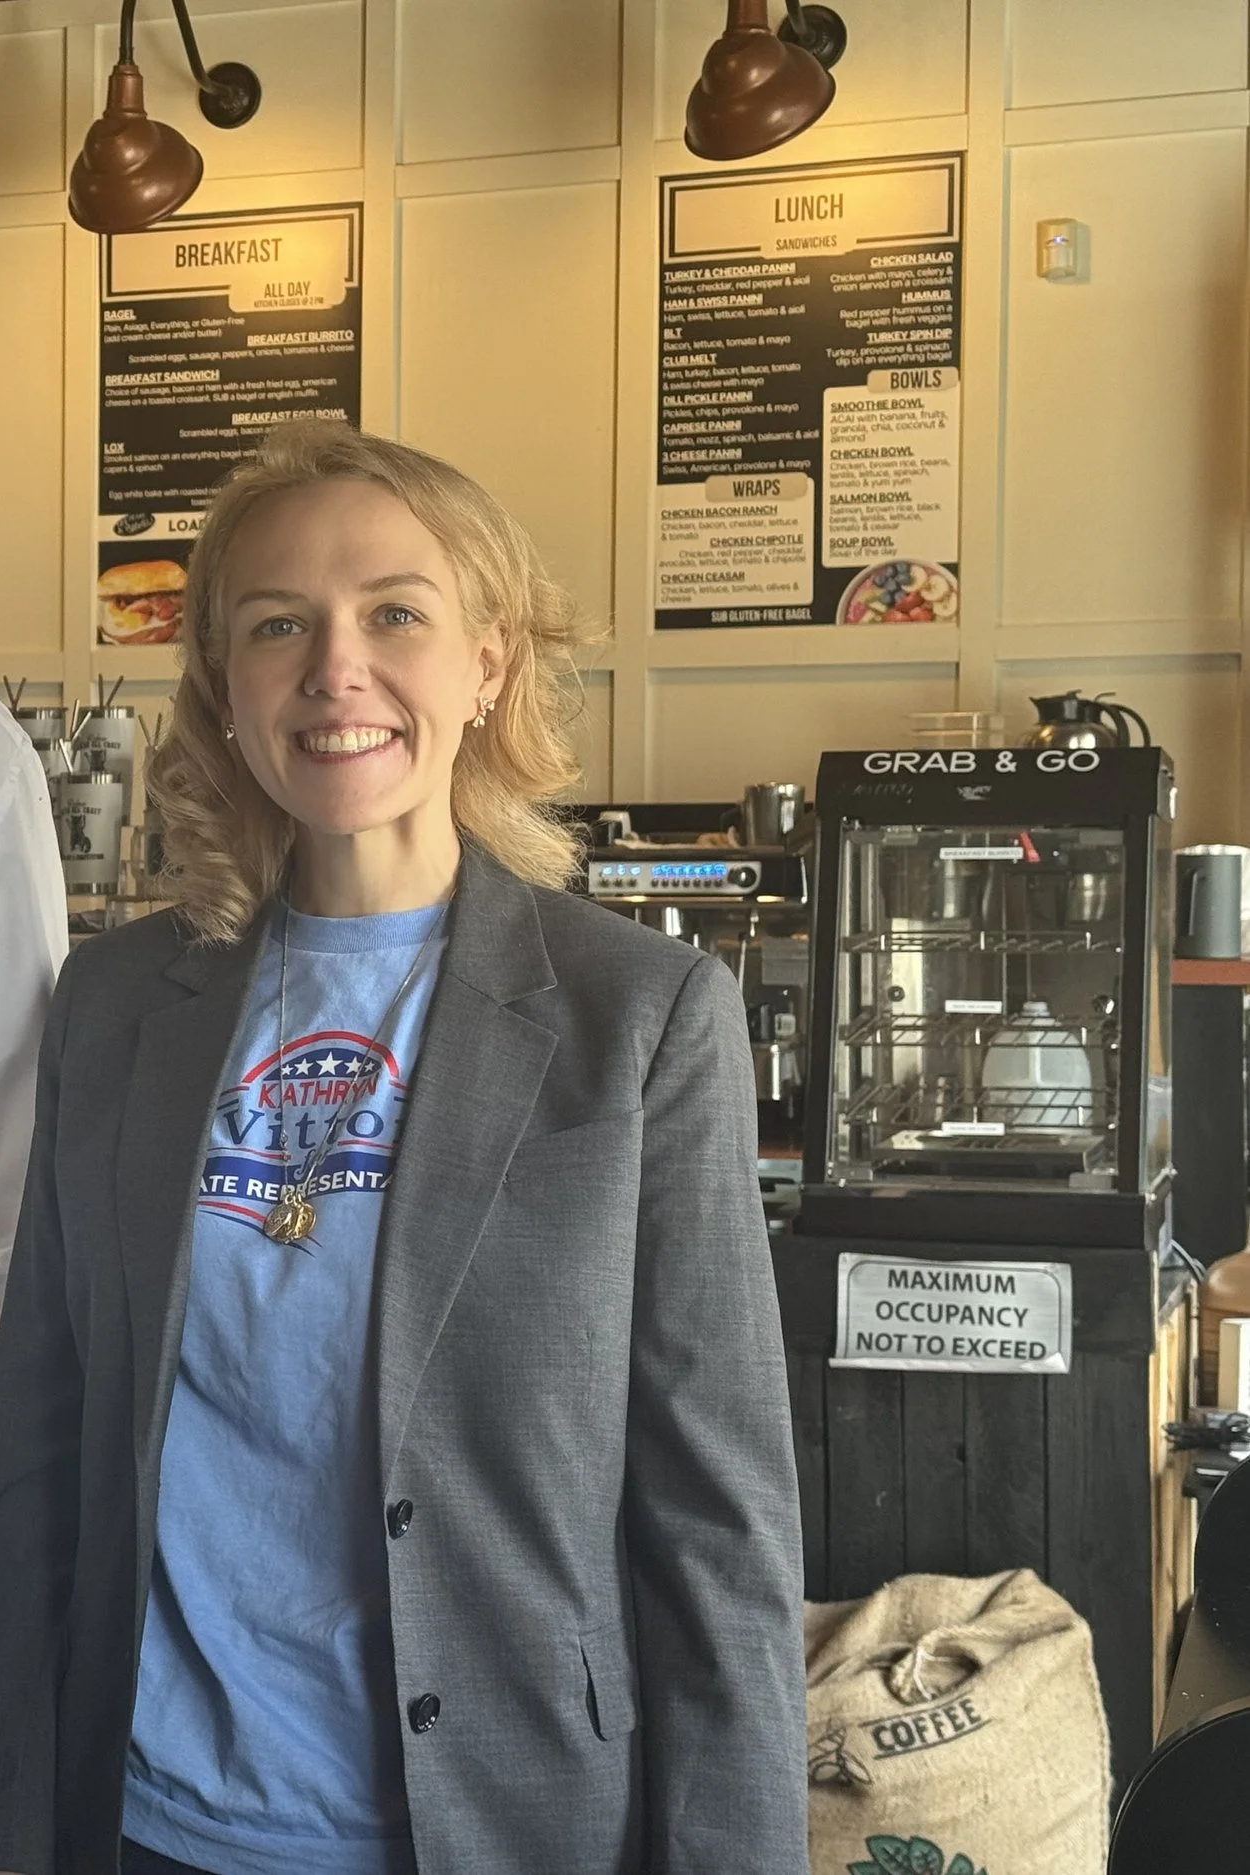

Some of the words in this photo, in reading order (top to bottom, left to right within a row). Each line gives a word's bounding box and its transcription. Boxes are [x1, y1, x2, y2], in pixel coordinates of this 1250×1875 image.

[774, 193, 843, 223] LUNCH
[776, 235, 837, 251] SANDWICHES
[175, 238, 282, 268] BREAKFAST
[870, 254, 917, 268] CHICKEN
[918, 252, 953, 264] SALAD
[664, 269, 704, 282] TURKEY
[712, 266, 760, 279] CHEDDAR
[762, 263, 796, 275] PANINI
[264, 283, 284, 298] ALL
[288, 281, 310, 297] DAY
[901, 291, 951, 303] HUMMUS
[664, 299, 686, 310] HAM
[696, 296, 728, 308] SWISS
[729, 294, 762, 306] PANINI
[104, 309, 136, 321] BAGEL
[248, 332, 307, 346] BREAKFAST
[309, 330, 354, 343] BURRITO
[664, 328, 682, 339] BLT
[867, 331, 908, 344] TURKEY
[934, 329, 952, 340] DIP
[663, 355, 689, 366] CLUB
[690, 353, 717, 365] MELT
[105, 372, 162, 386] BREAKFAST
[164, 369, 220, 384] SANDWICH
[890, 370, 942, 389] BOWLS
[663, 395, 684, 406] DILL
[686, 393, 719, 405] PICKLE
[720, 391, 752, 403] PANINI
[830, 401, 889, 413] SMOOTHIE
[891, 399, 924, 411] BOWL
[232, 411, 291, 424] BREAKFAST
[663, 422, 707, 434] CAPRESE
[708, 420, 741, 432] PANINI
[104, 443, 125, 454] LOX
[670, 450, 707, 462] CHEESE
[708, 449, 742, 460] PANINI
[830, 448, 878, 460] CHICKEN
[880, 447, 914, 458] BOWL
[733, 479, 780, 498] WRAPS
[830, 493, 877, 504] SALMON
[879, 492, 912, 503] BOWL
[661, 508, 703, 520] CHICKEN
[705, 507, 740, 518] BACON
[742, 505, 778, 516] RANCH
[710, 537, 751, 548] CHICKEN
[752, 534, 803, 546] CHIPOTLE
[830, 538, 860, 548] SOUP
[862, 537, 894, 547] BOWL
[661, 573, 702, 583] CHICKEN
[704, 572, 745, 582] CEASAR
[712, 611, 730, 622] SUB
[732, 610, 783, 622] GLUTEN-FREE
[785, 609, 811, 620] BAGEL
[863, 752, 977, 773] GRAB
[995, 751, 1017, 773] &
[1036, 750, 1100, 773] GO
[258, 1073, 378, 1108] KATHRYN
[199, 1175, 240, 1194] ATE
[887, 1268, 1017, 1296] MAXIMUM
[875, 1300, 1029, 1329] OCCUPANCY
[855, 1330, 910, 1355] NOT
[912, 1333, 946, 1356] TO
[951, 1336, 1047, 1361] EXCEED
[871, 1699, 982, 1753] COFFEE
